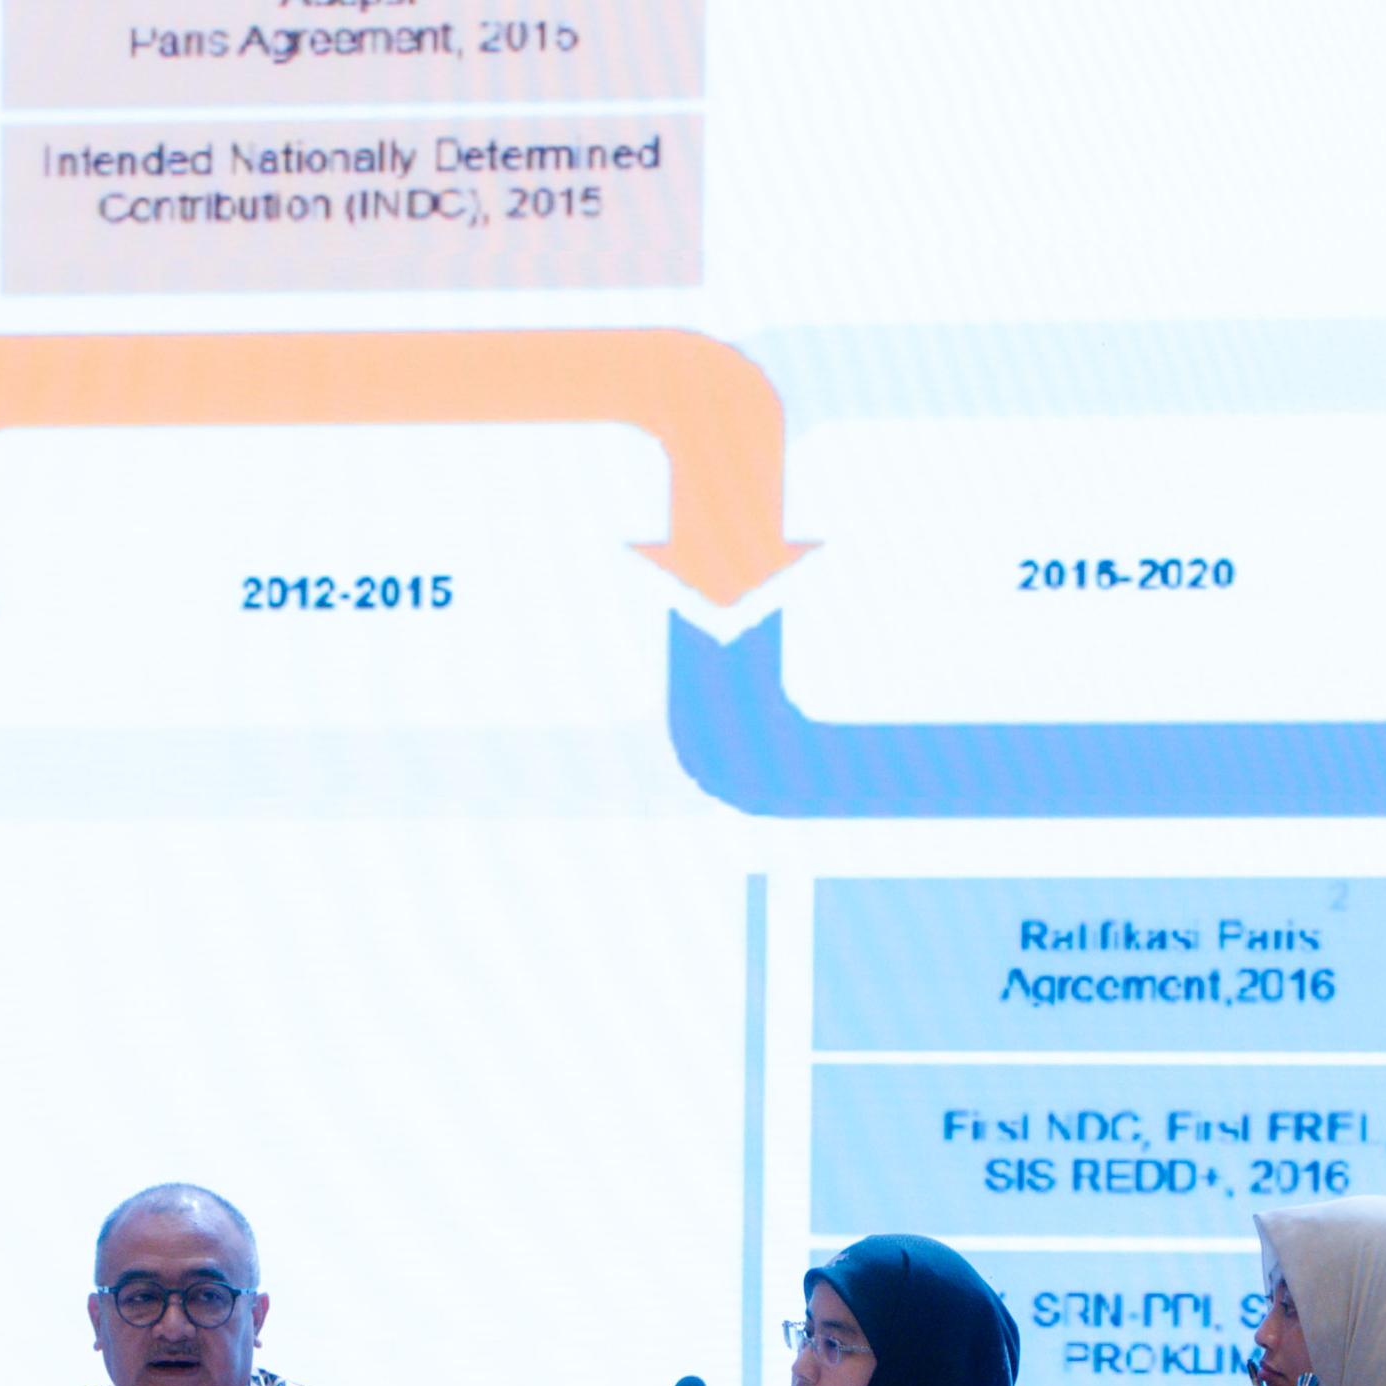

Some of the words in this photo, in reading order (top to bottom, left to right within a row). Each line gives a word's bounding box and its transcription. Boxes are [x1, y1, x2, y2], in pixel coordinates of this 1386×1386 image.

[129, 26, 230, 58] Paris
[238, 23, 463, 65] Agreement,
[478, 20, 580, 53] 2015
[45, 142, 214, 177] Intended
[230, 139, 417, 178] Nationally
[435, 133, 662, 173] Determined
[97, 190, 333, 224] Contribution
[344, 186, 491, 228] (INDC),
[505, 185, 602, 219] 2015
[241, 574, 453, 610] 2012-2015
[1020, 917, 1201, 952] Ratifikasi
[1217, 917, 1322, 952] Paris
[942, 1109, 1030, 1142] First
[1047, 1109, 1151, 1151] NDC,
[1166, 1109, 1251, 1143] First
[984, 1157, 1057, 1194] SIS
[1071, 1157, 1235, 1199] REDD+,
[1248, 1158, 1351, 1195] 2016
